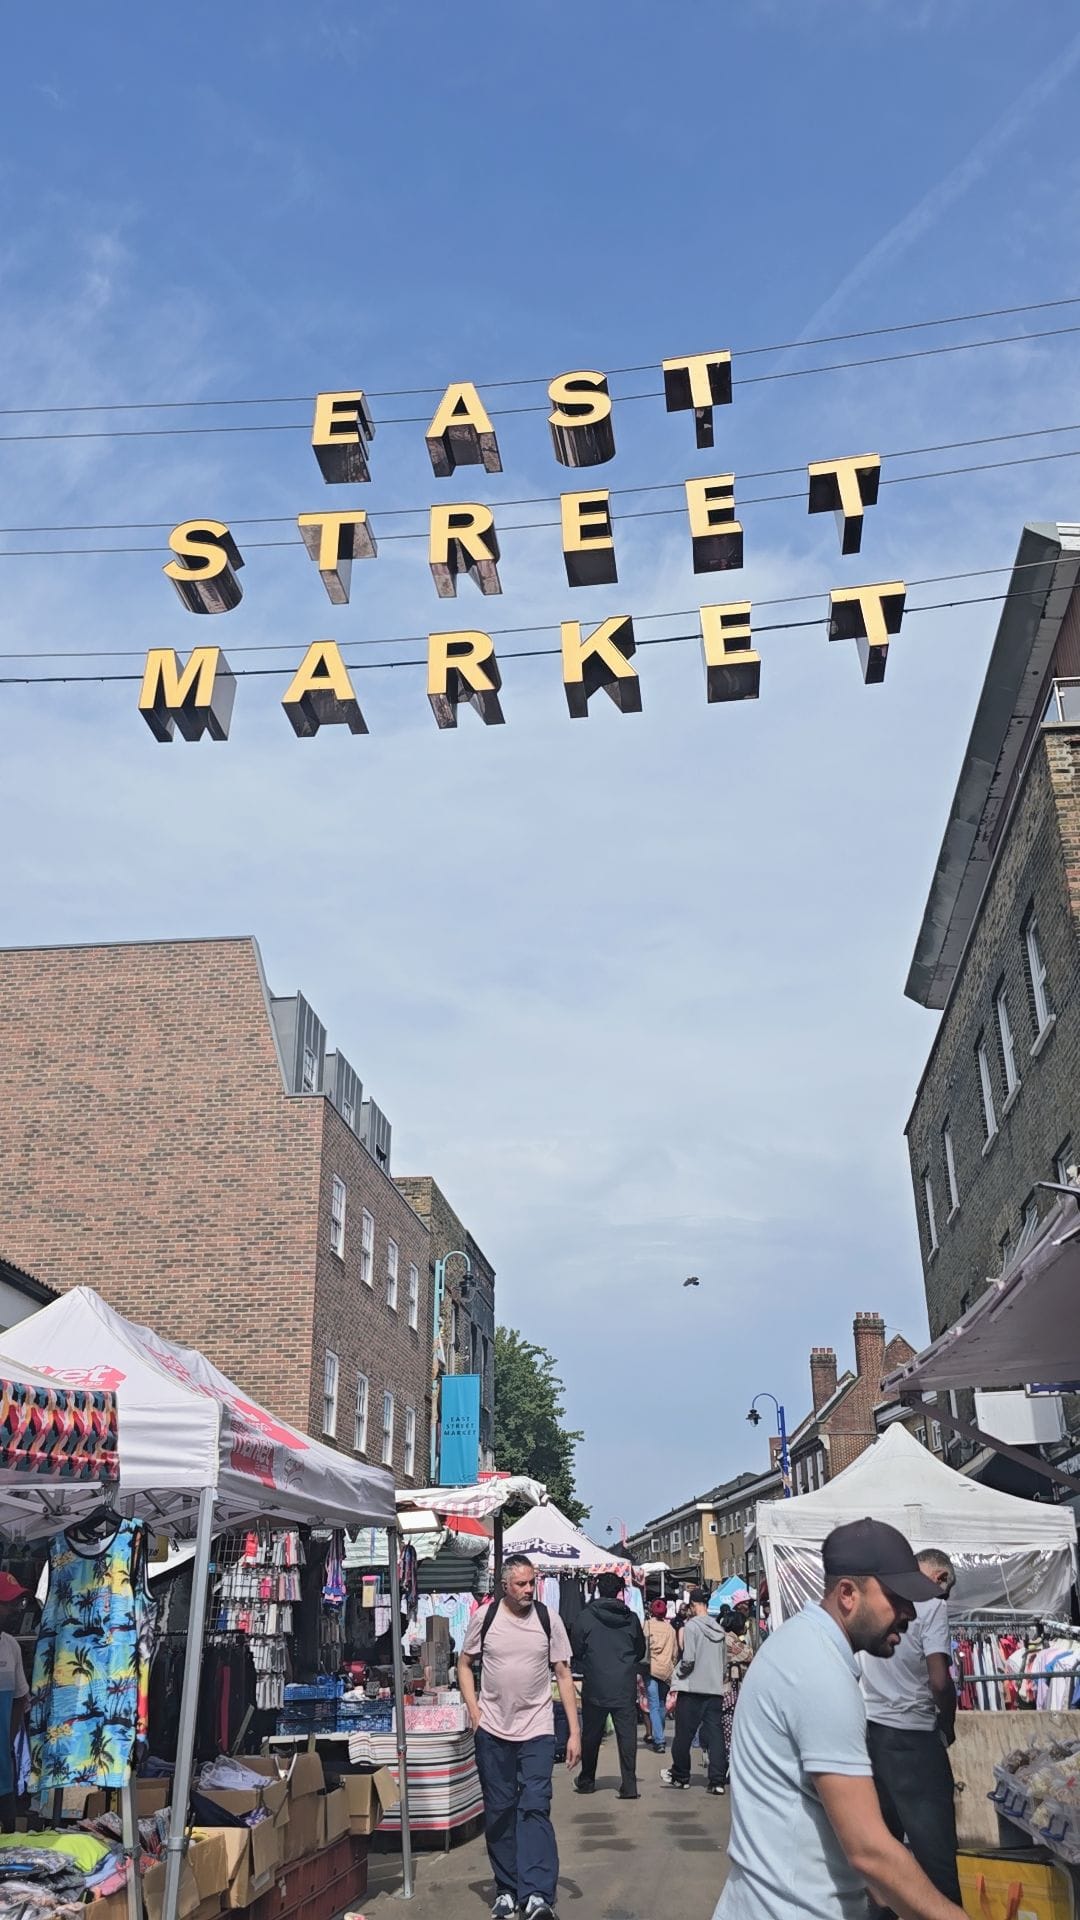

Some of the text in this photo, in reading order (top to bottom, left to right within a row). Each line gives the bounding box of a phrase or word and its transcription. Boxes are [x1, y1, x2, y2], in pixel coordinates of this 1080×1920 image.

[311, 350, 733, 446] EAST
[162, 453, 882, 581] STREET
[138, 581, 906, 710] MARKET
